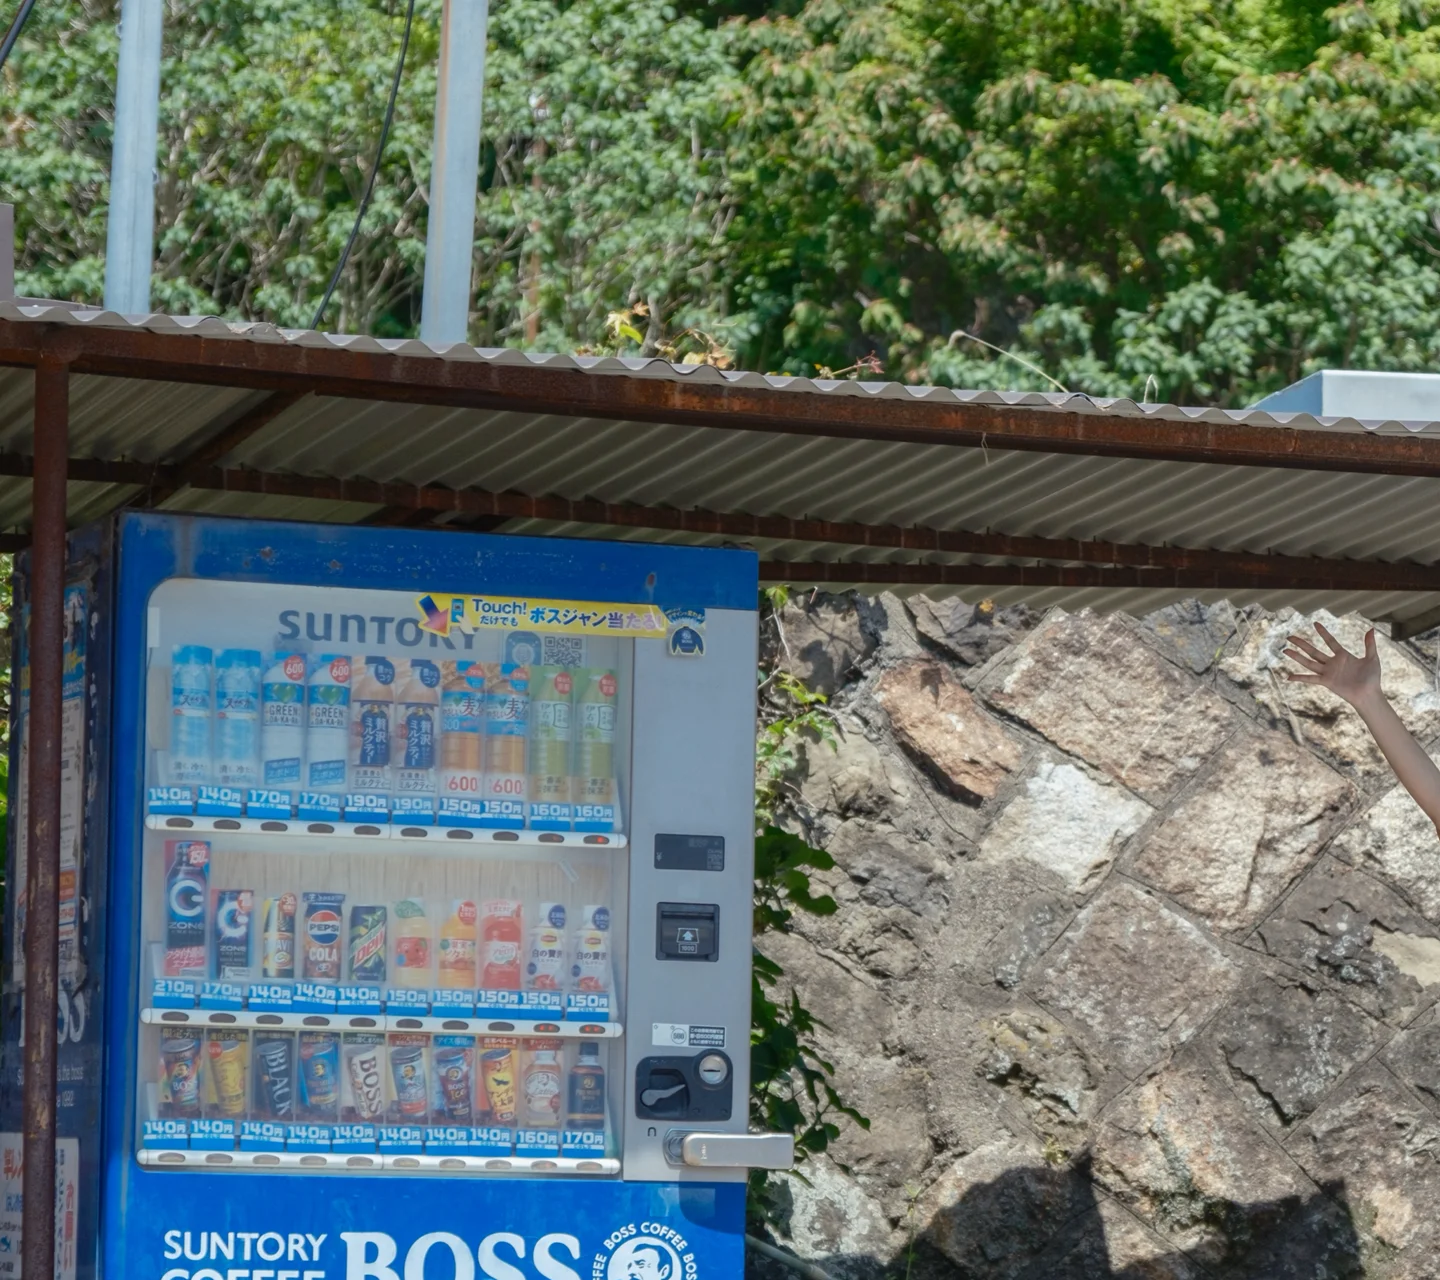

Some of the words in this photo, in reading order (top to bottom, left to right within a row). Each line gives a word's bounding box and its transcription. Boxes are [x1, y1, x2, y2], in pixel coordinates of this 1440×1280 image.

[472, 598, 527, 615] Touch!
[480, 615, 518, 626] だけでも
[530, 609, 665, 632] ボスジャン当たる!
[448, 775, 478, 792] 600
[149, 787, 191, 801] 140円
[250, 789, 290, 804] 170円
[345, 795, 387, 808] 190円
[441, 798, 481, 814] 150円
[575, 805, 613, 818] 160円
[309, 922, 339, 933] PEPSI
[308, 947, 338, 962] COLA
[155, 979, 195, 993] 210円
[203, 982, 242, 997] 170円
[296, 983, 336, 999] 140円
[522, 992, 560, 1005] 150円
[265, 1050, 293, 1117] BLACK
[359, 1055, 383, 1115] BOSS
[144, 1121, 186, 1134] 140円
[518, 1130, 557, 1144] 160円
[565, 1130, 604, 1144] 170円
[163, 1230, 328, 1262] SUNTORY
